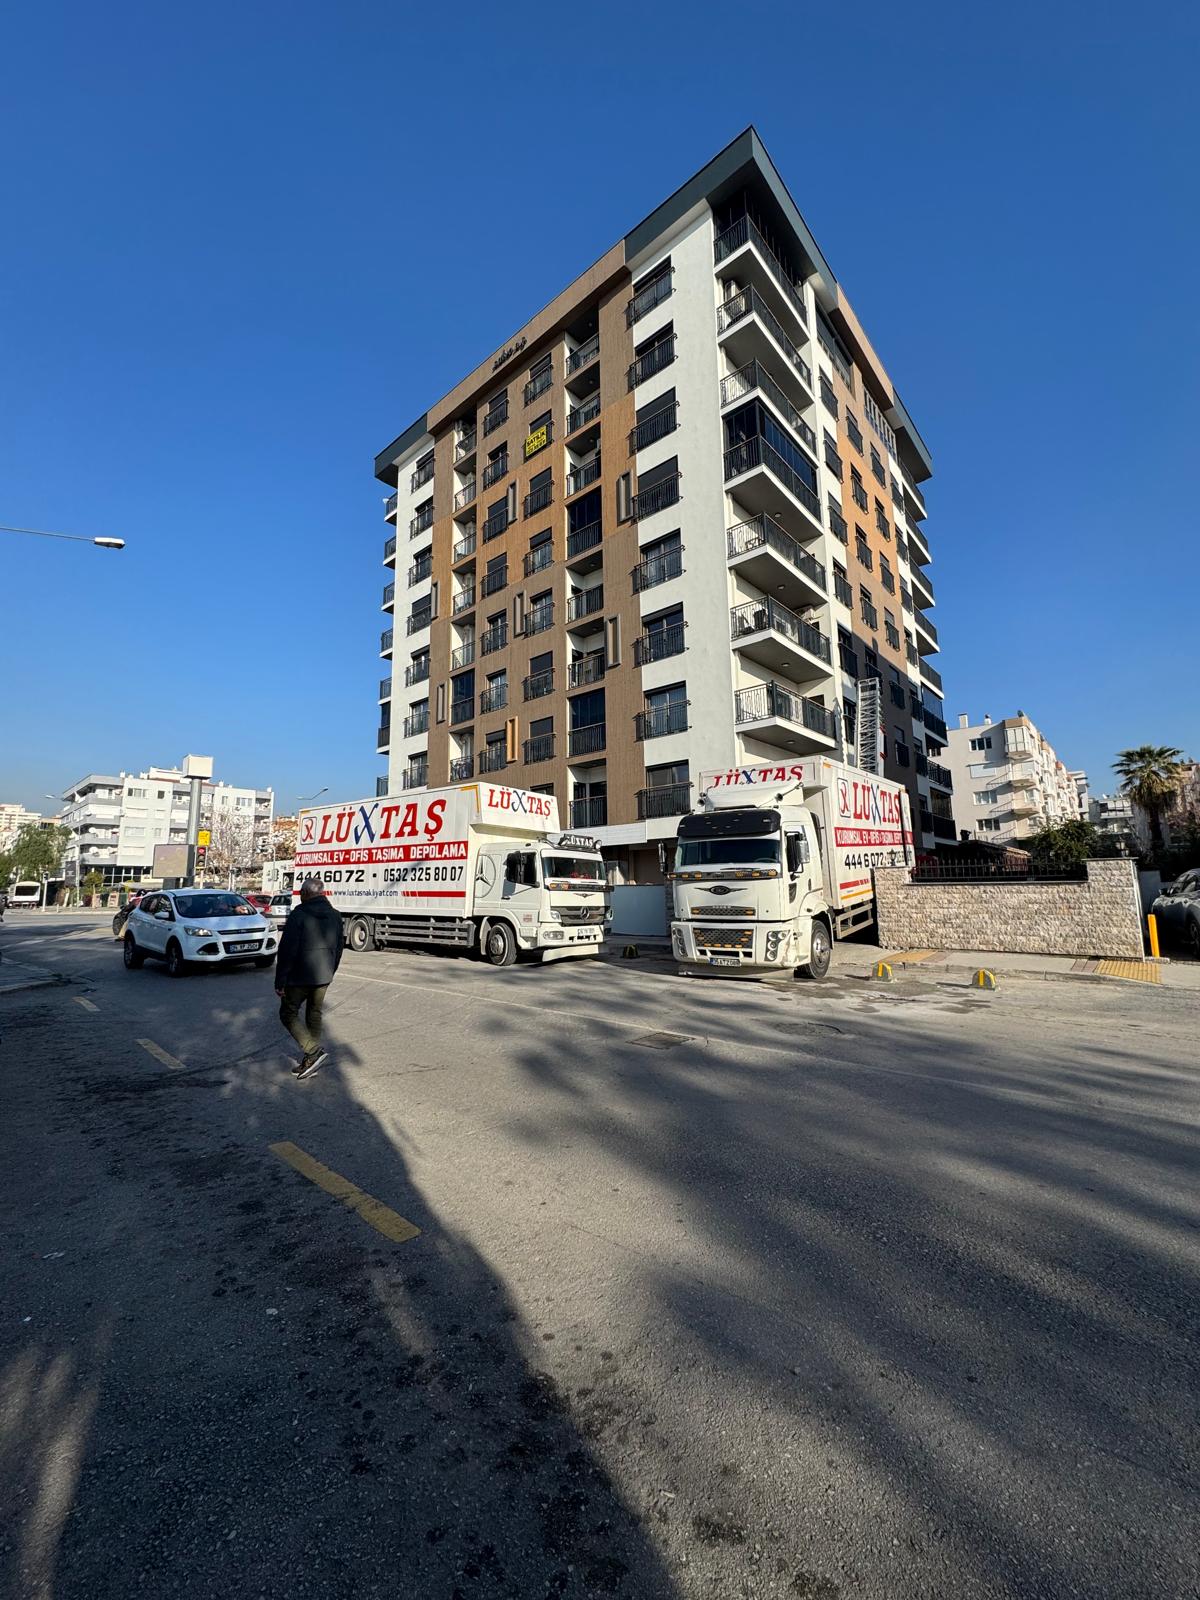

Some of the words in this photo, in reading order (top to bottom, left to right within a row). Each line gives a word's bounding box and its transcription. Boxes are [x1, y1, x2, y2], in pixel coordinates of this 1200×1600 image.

[487, 787, 552, 819] LÜXTAŞ
[853, 779, 900, 829] LÜXTAŞ
[318, 799, 447, 845] LÜXTAŞ
[295, 852, 332, 864] KURUMSAL
[410, 843, 467, 859] DEPOLAMA
[383, 868, 408, 882] 0532
[411, 867, 431, 881] 325
